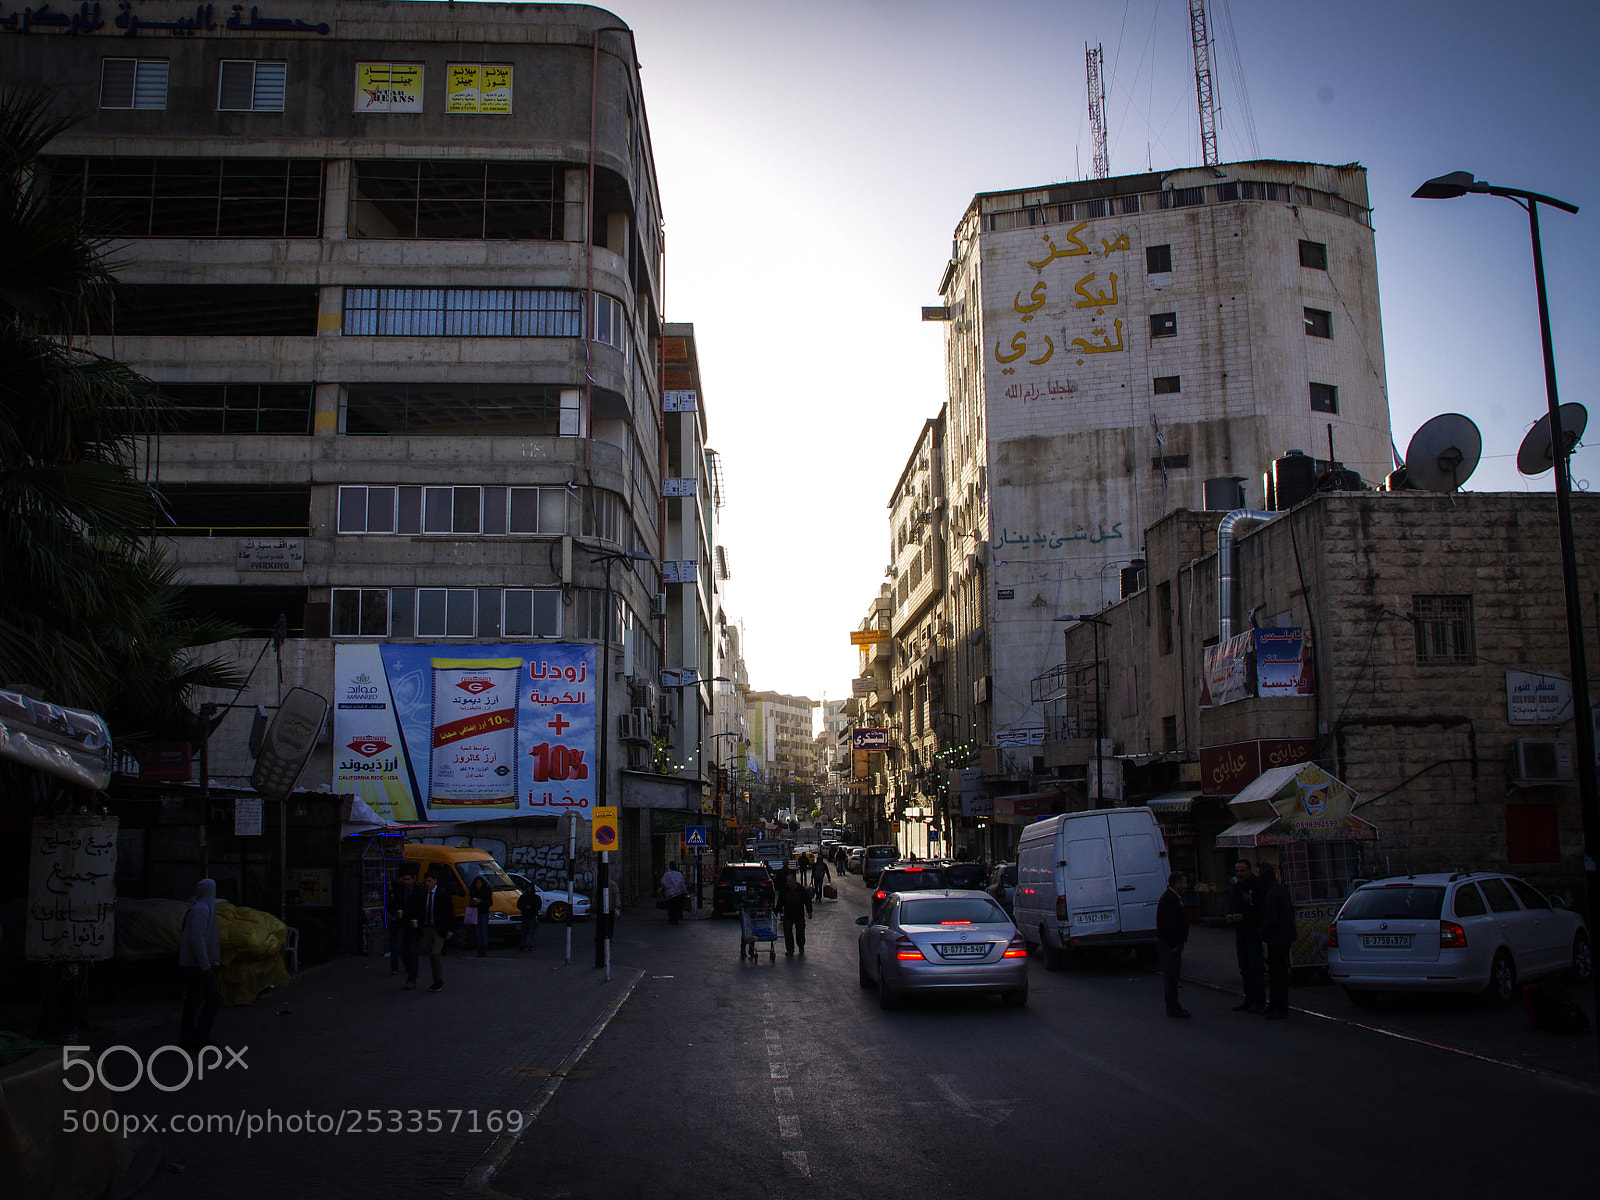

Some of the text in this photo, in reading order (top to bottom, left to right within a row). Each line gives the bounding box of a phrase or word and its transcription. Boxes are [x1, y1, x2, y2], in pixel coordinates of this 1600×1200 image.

[0, 2, 330, 37] محطة البيرة المركزي
[374, 95, 415, 103] JEANS
[1027, 221, 1130, 269] مركز
[250, 561, 290, 570] PARKING
[1260, 629, 1302, 644] نابلس
[1261, 654, 1303, 668] سنتر
[529, 661, 587, 683] زودنا
[530, 690, 586, 707] الكمية
[339, 756, 398, 772] أرز ديموند
[528, 742, 589, 783] 10%
[511, 844, 566, 870] FREE
[46, 862, 109, 894] جميع
